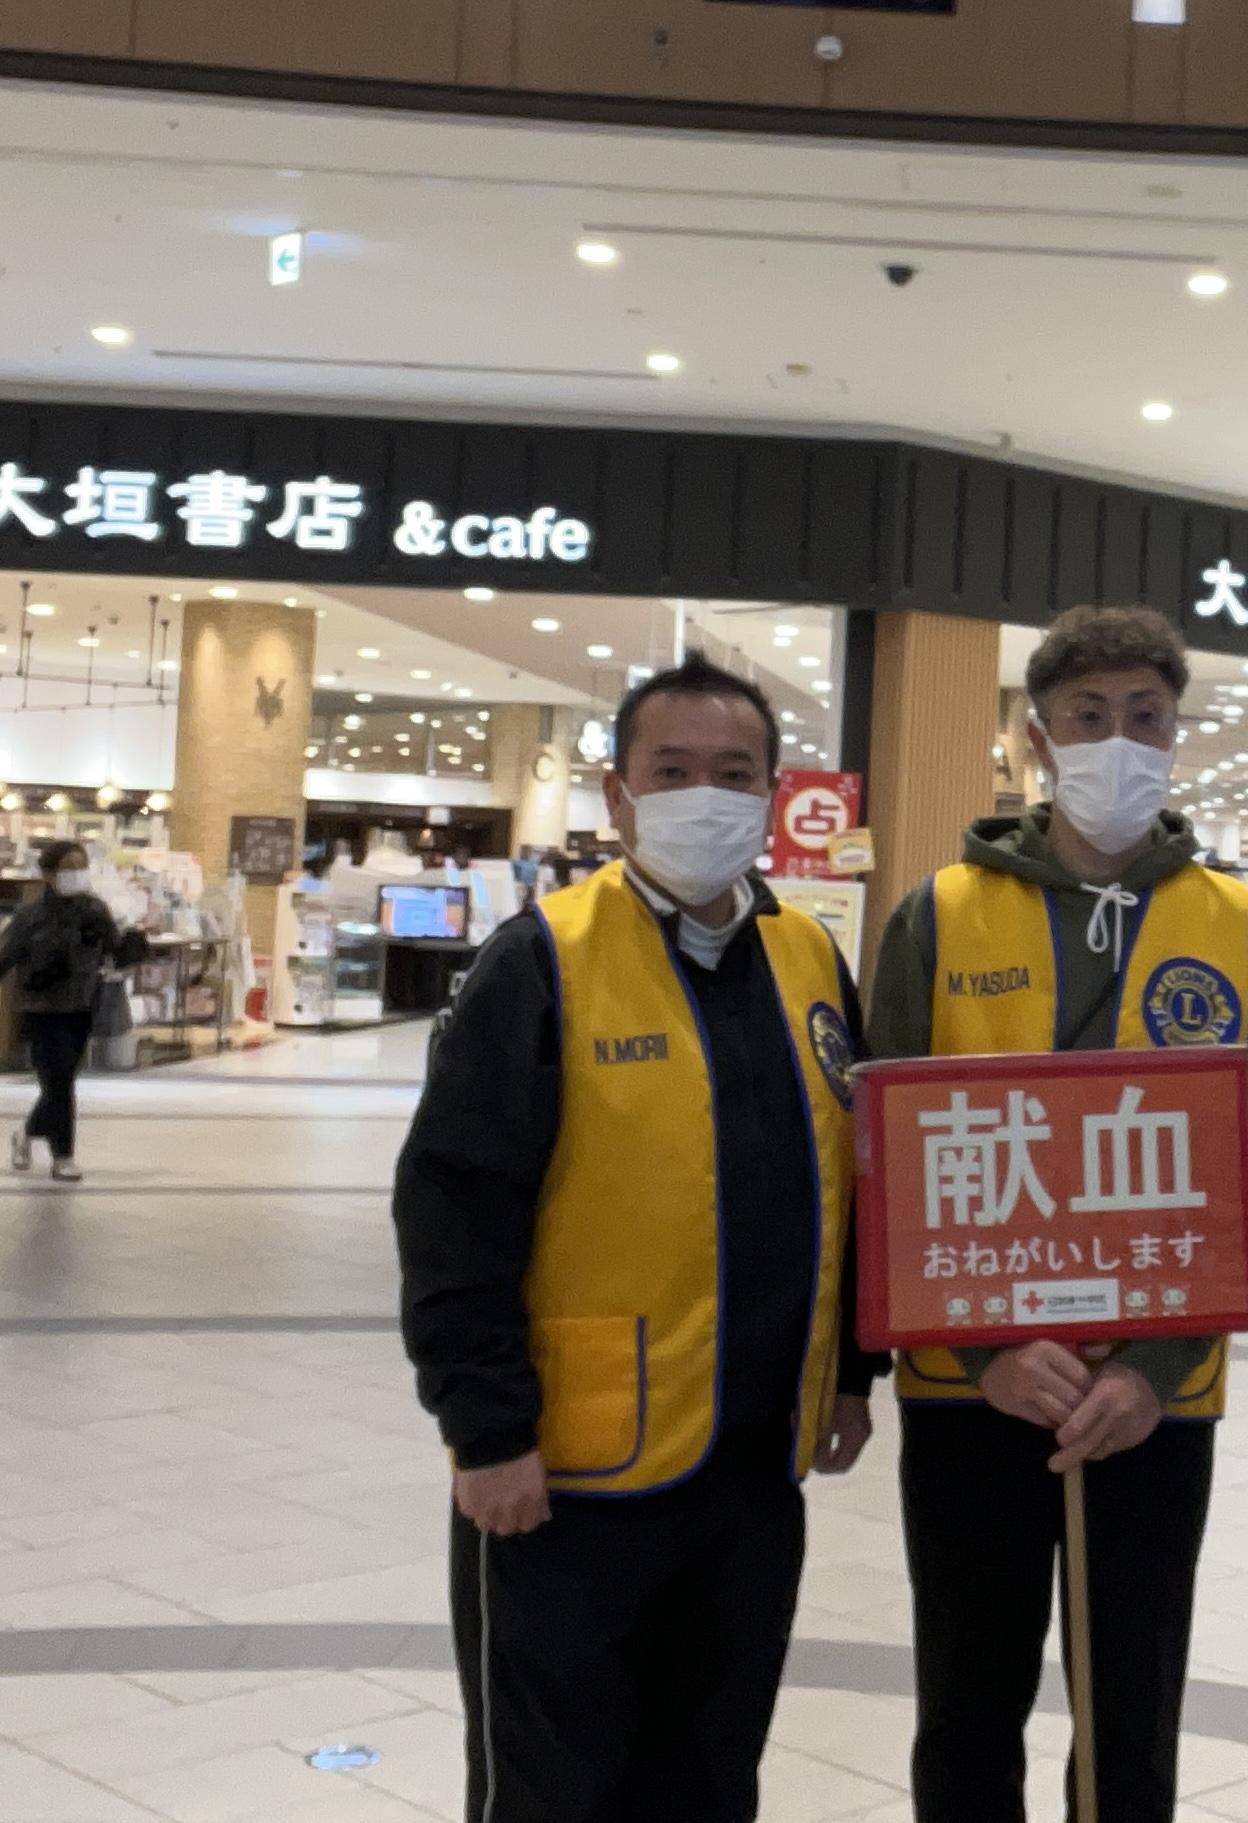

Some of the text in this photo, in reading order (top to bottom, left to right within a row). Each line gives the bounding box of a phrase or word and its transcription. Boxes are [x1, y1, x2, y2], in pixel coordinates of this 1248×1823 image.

[0, 462, 591, 562] 大垣書店 &cafe
[947, 967, 1030, 996] M.YASUDA
[918, 1086, 1207, 1229] 献血
[923, 1230, 1205, 1279] おねがいします
